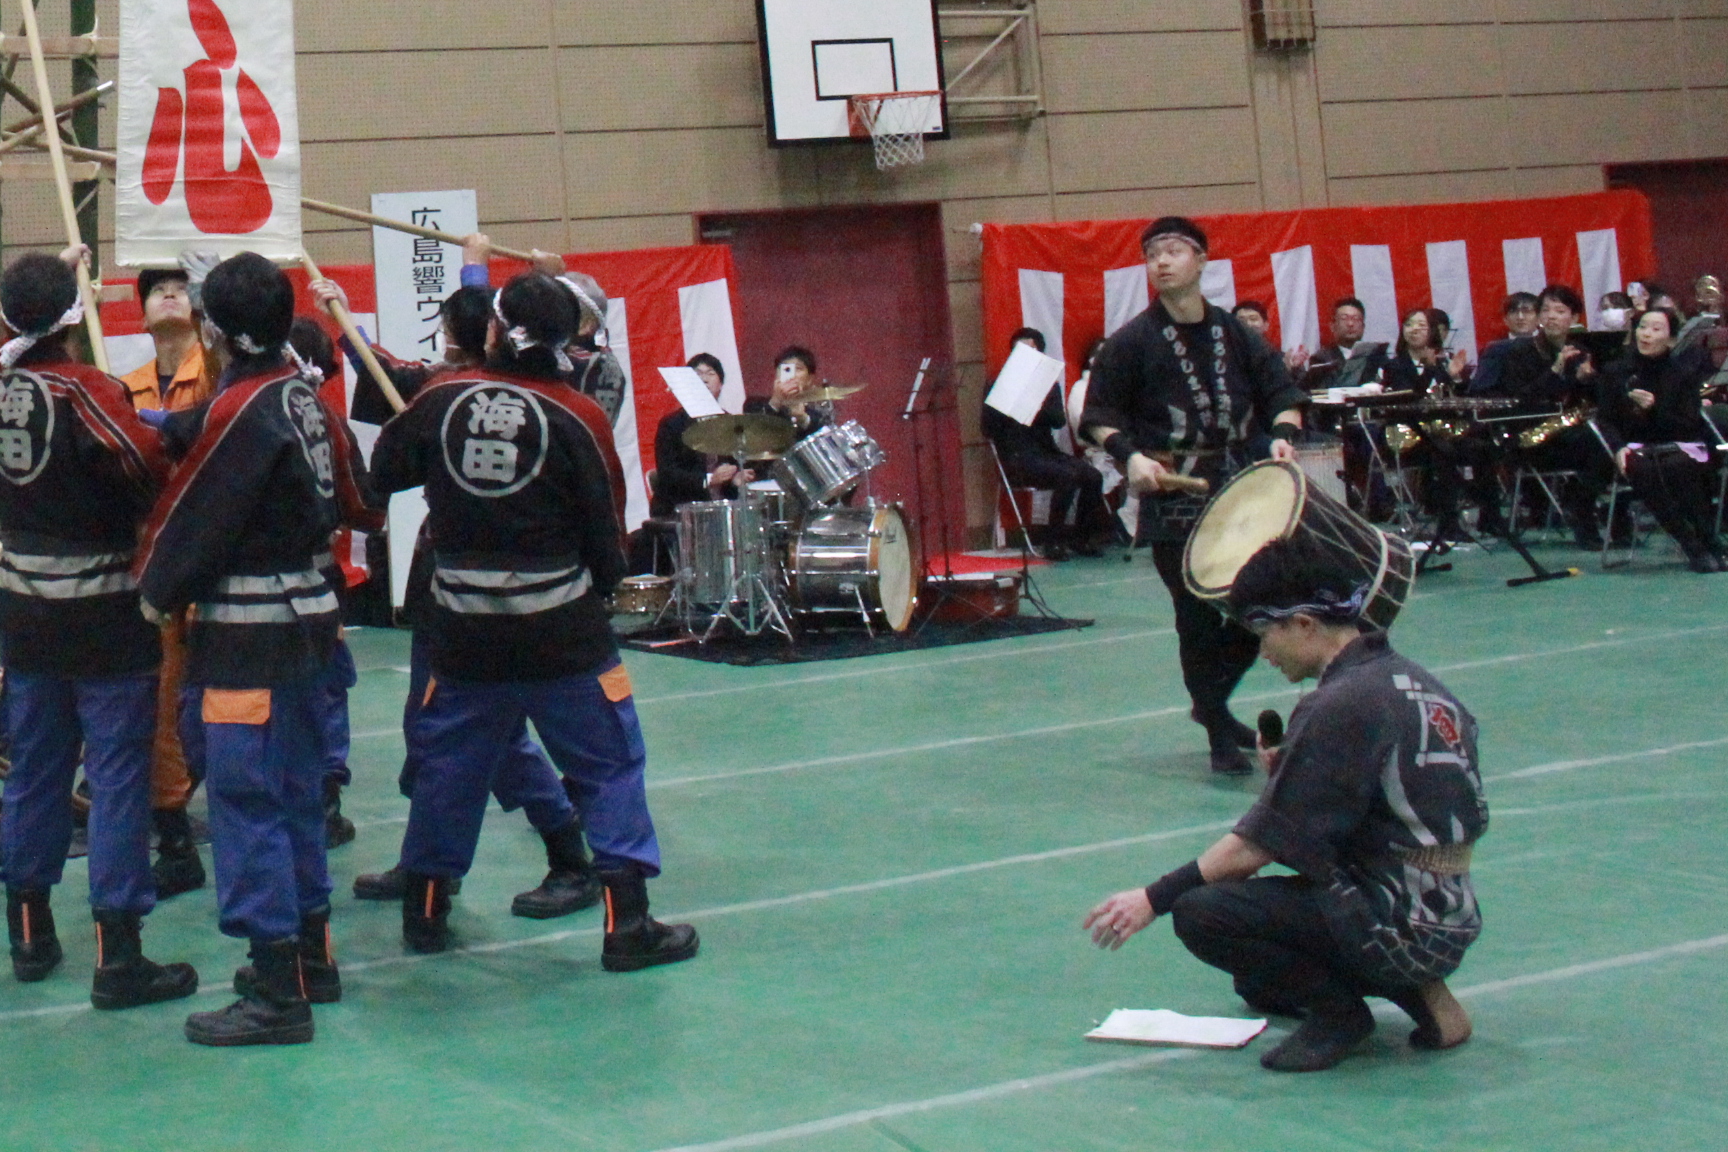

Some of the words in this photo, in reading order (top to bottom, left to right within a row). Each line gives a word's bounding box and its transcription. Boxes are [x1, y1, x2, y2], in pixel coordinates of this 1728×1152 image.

[411, 207, 445, 364] 広島響ウイ
[290, 393, 332, 482] 海田
[462, 392, 526, 482] 海田
